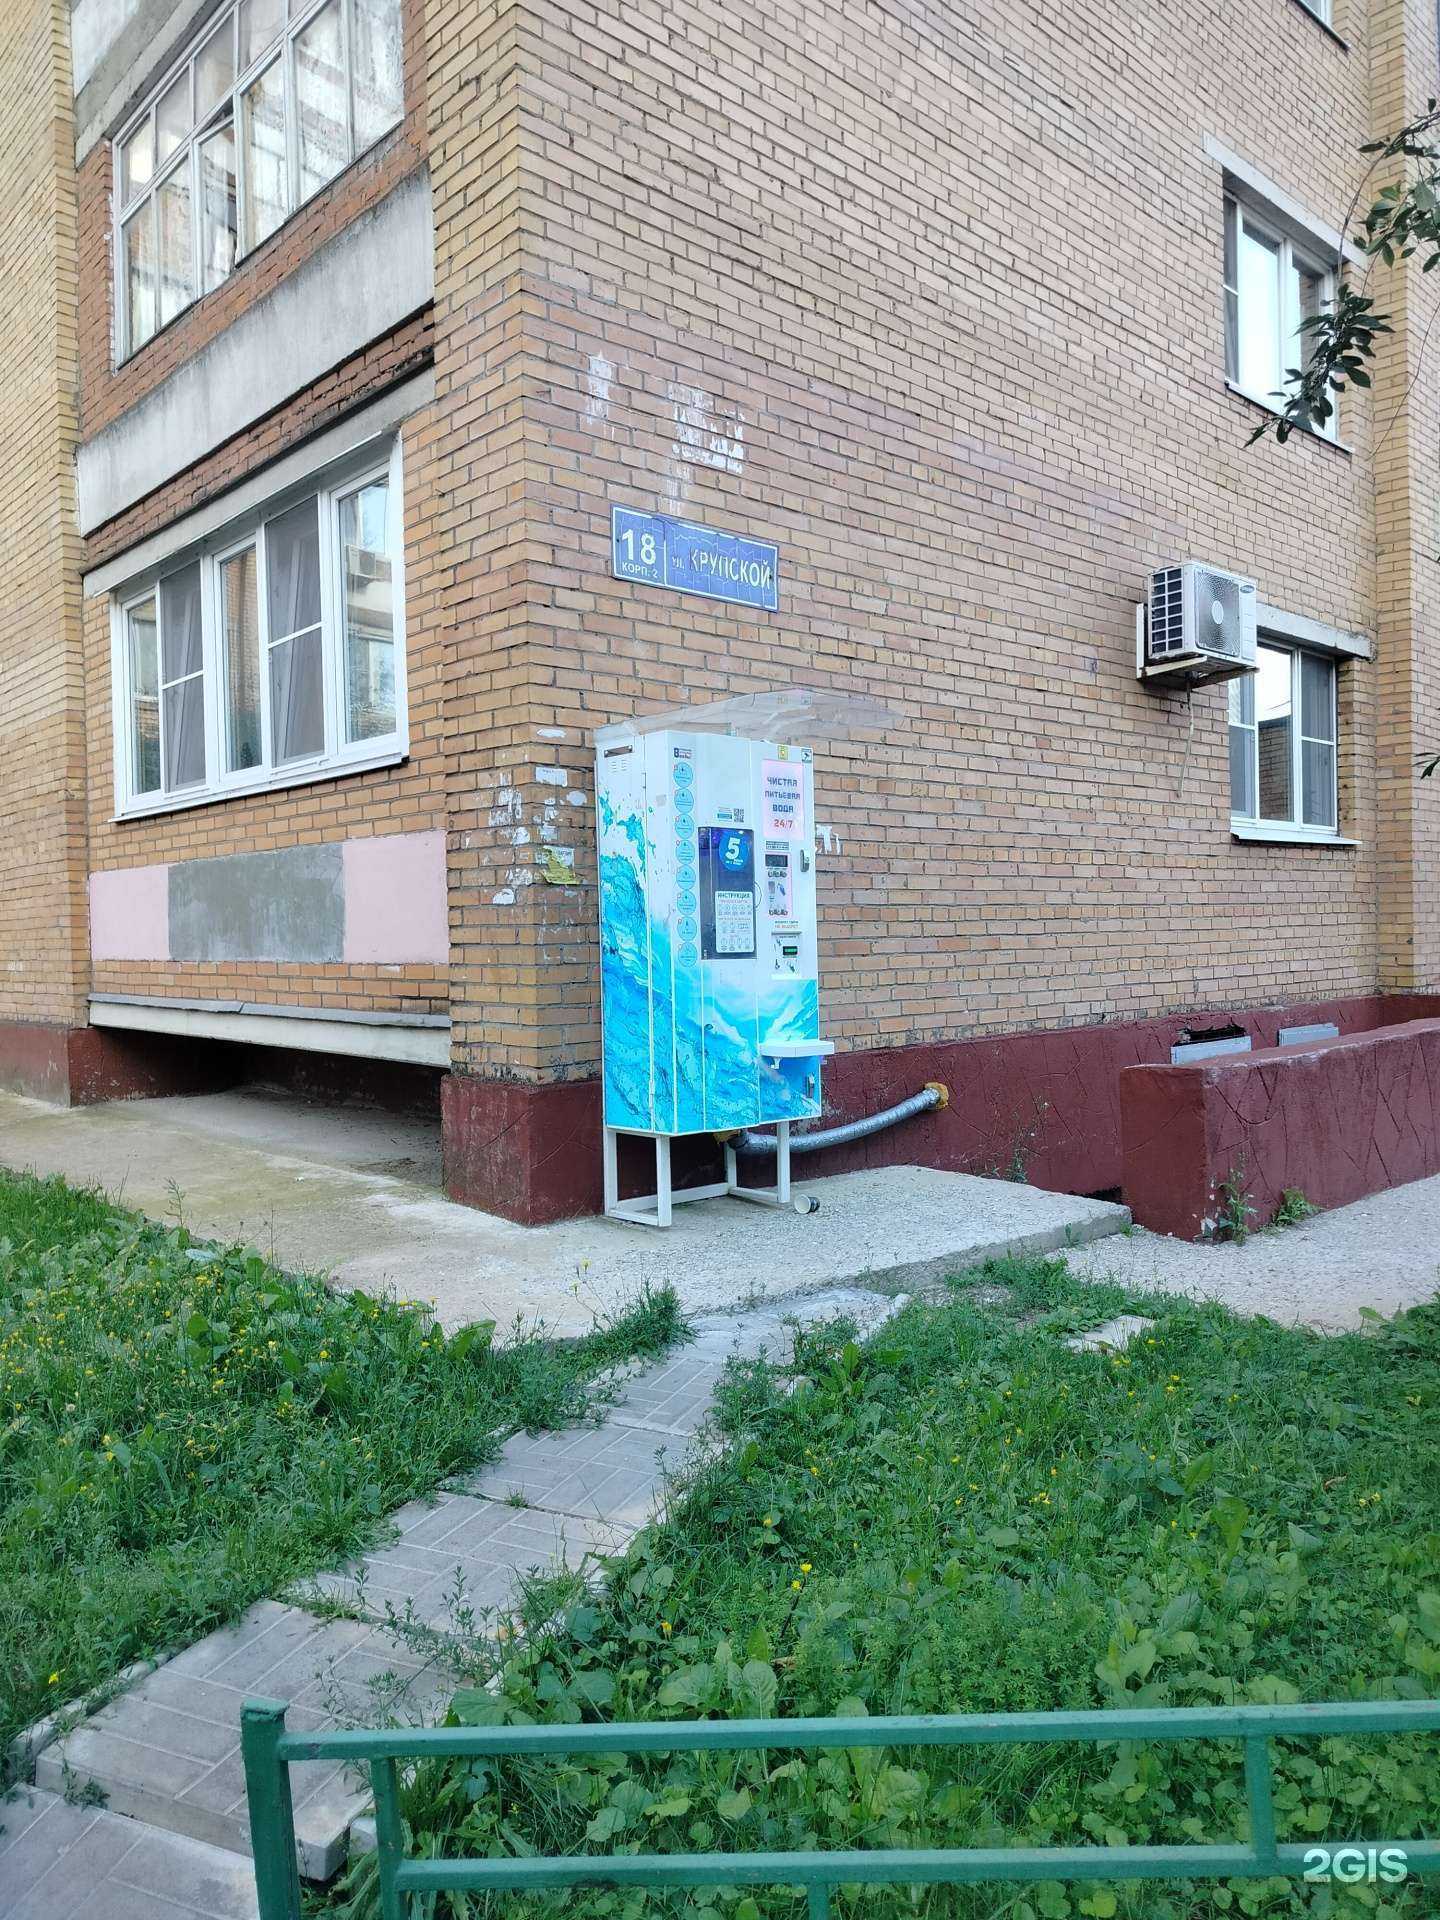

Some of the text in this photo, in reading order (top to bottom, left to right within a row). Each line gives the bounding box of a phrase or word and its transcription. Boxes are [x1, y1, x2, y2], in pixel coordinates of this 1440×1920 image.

[622, 529, 657, 565] 18
[622, 562, 659, 579] КОРП. 2
[690, 549, 772, 590] КРУПСКОЙ
[767, 776, 798, 787] ЧИСТАЯ
[764, 790, 801, 800] ПИТЬЕВАЯ
[772, 804, 794, 813] ВОДА
[774, 819, 793, 829] 24/7
[725, 837, 741, 860] 5
